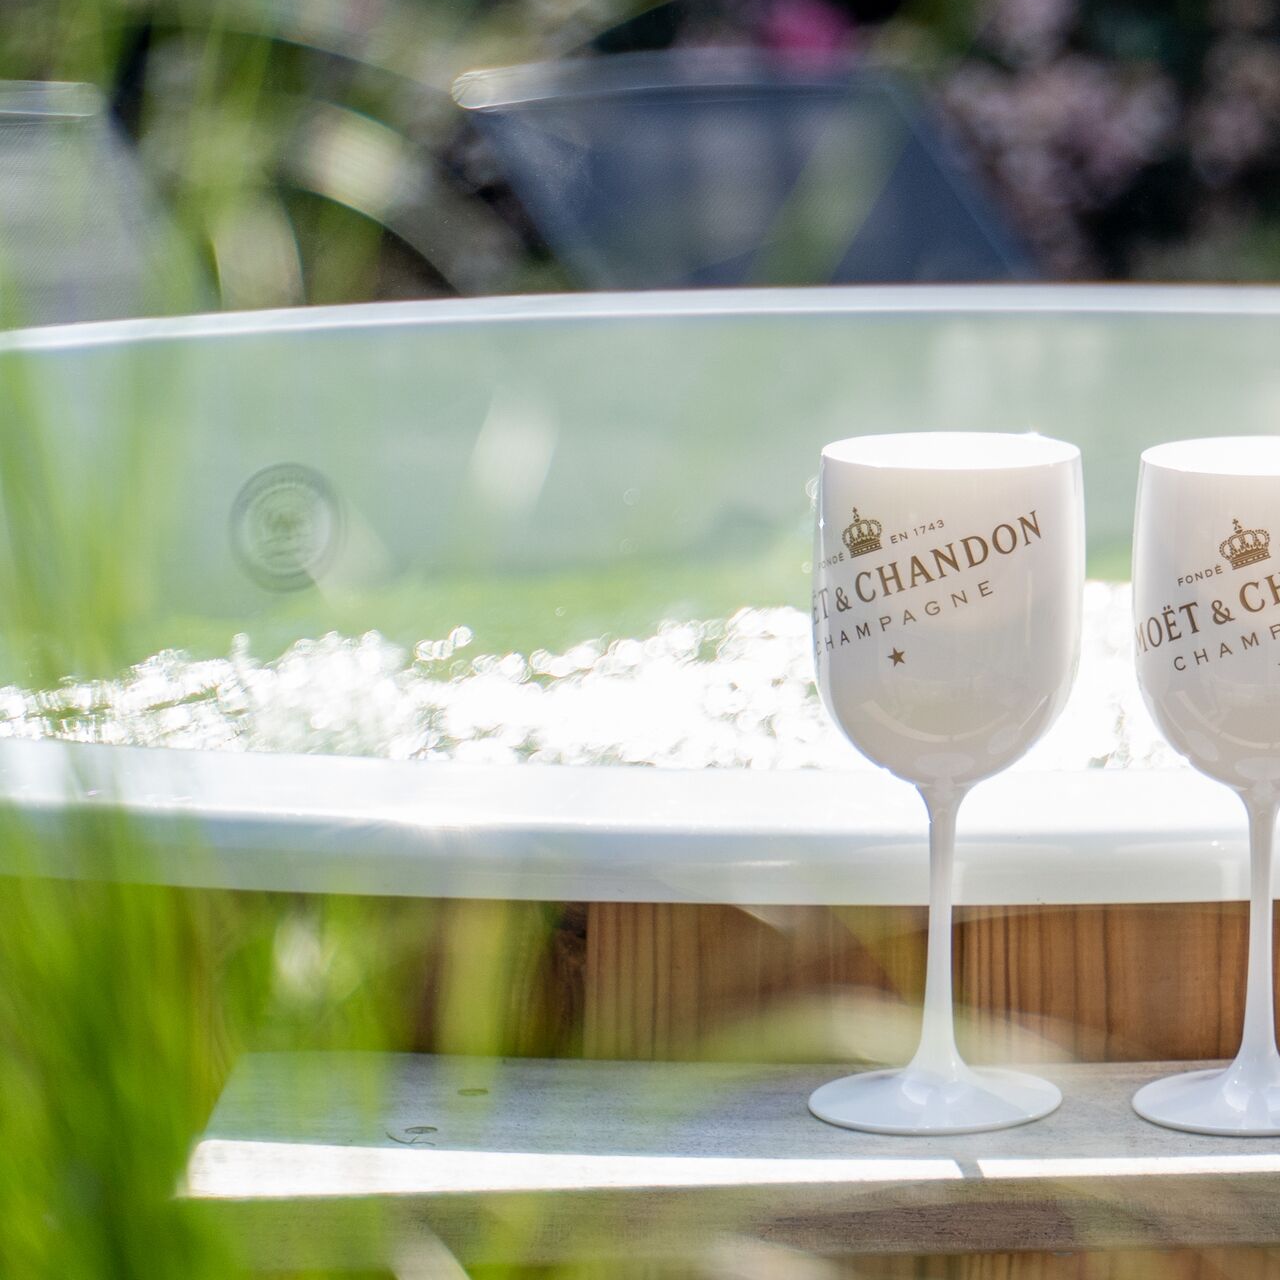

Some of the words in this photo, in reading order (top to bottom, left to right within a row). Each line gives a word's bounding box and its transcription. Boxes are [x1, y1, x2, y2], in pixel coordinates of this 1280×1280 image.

[890, 531, 908, 545] EN
[913, 519, 945, 537] 1743
[835, 586, 853, 613] &
[855, 510, 1042, 604] CHANDON
[1178, 564, 1223, 587] FONDÉ
[1212, 599, 1236, 626] &
